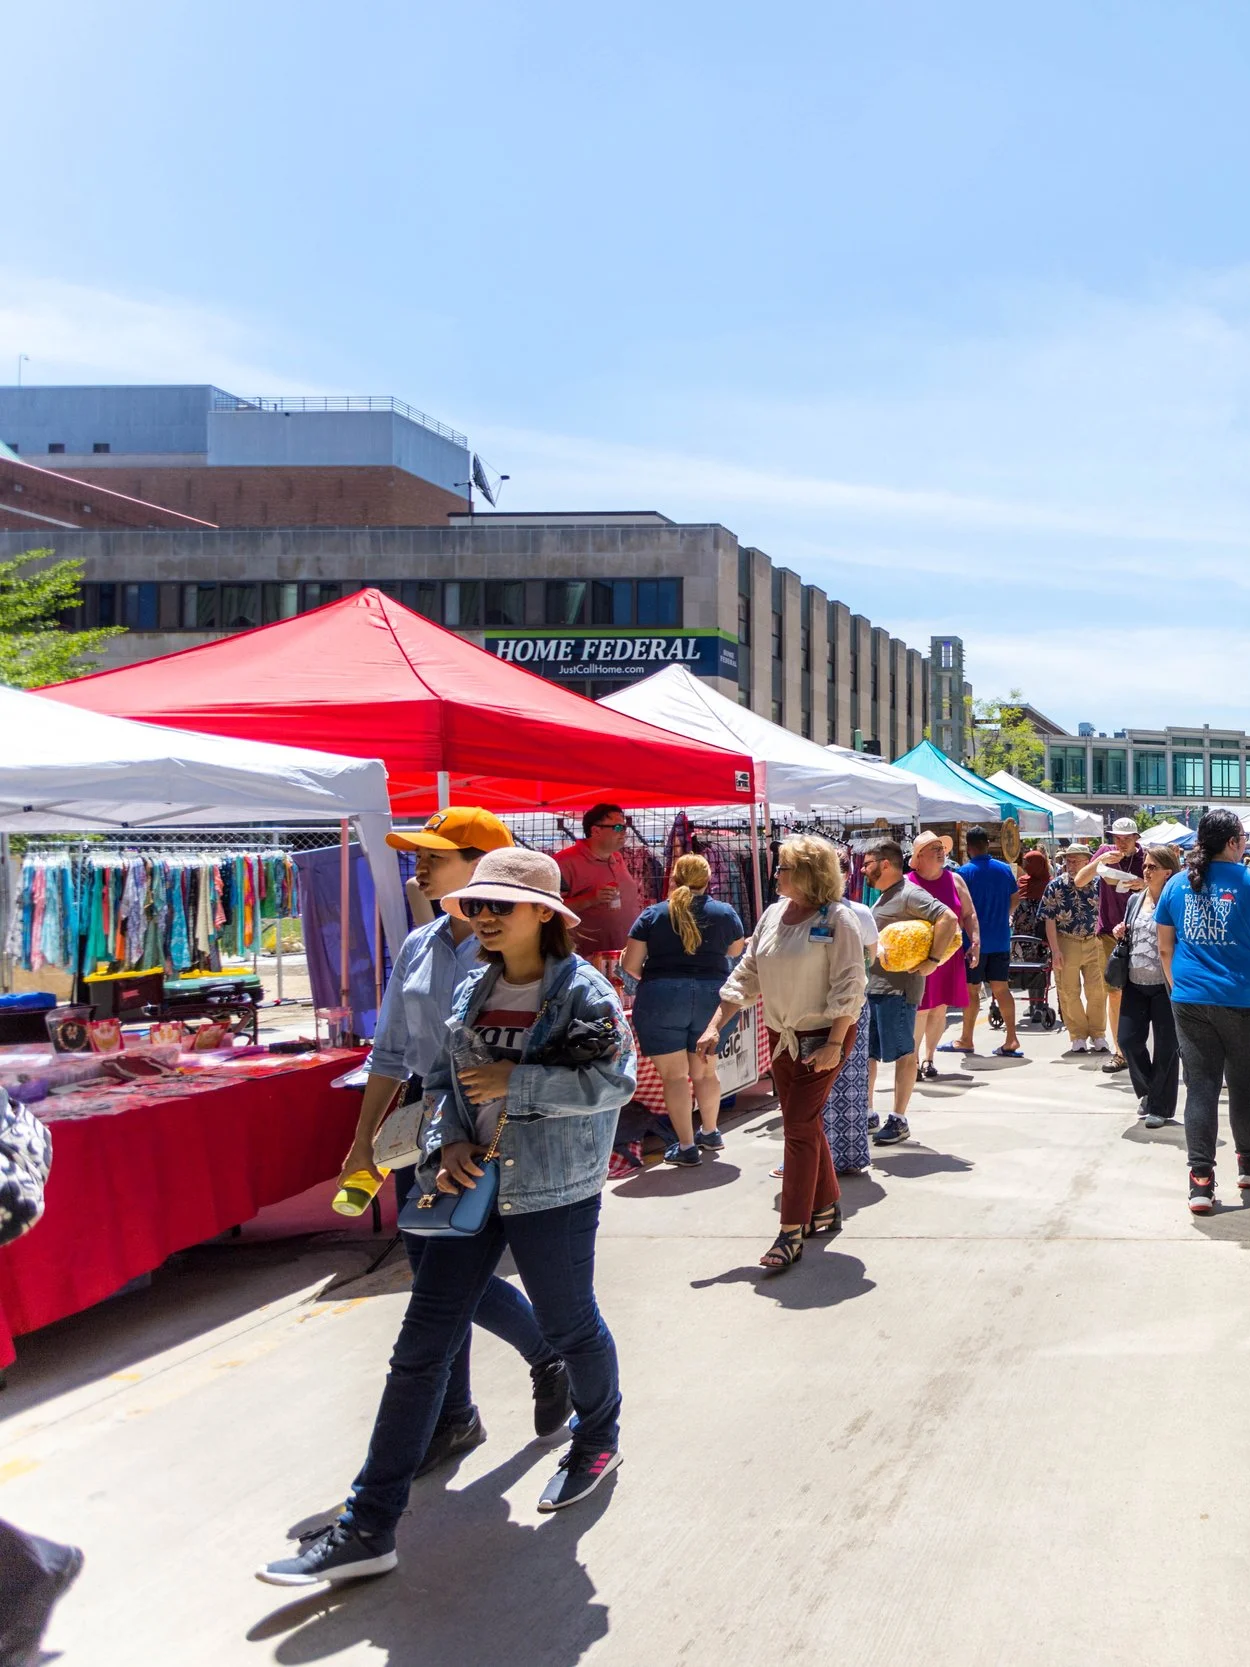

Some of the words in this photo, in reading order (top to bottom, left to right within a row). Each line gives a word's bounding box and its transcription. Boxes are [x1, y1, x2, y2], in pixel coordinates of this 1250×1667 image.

[497, 639, 574, 661] HOME
[580, 638, 700, 660] FEDERAL
[558, 664, 645, 675] JustCallHome.com
[1185, 903, 1210, 911] WHAT
[1213, 902, 1232, 913] YOU
[1184, 909, 1231, 921] REALLY
[1183, 919, 1228, 930] REALLY
[1183, 928, 1228, 940] WANT
